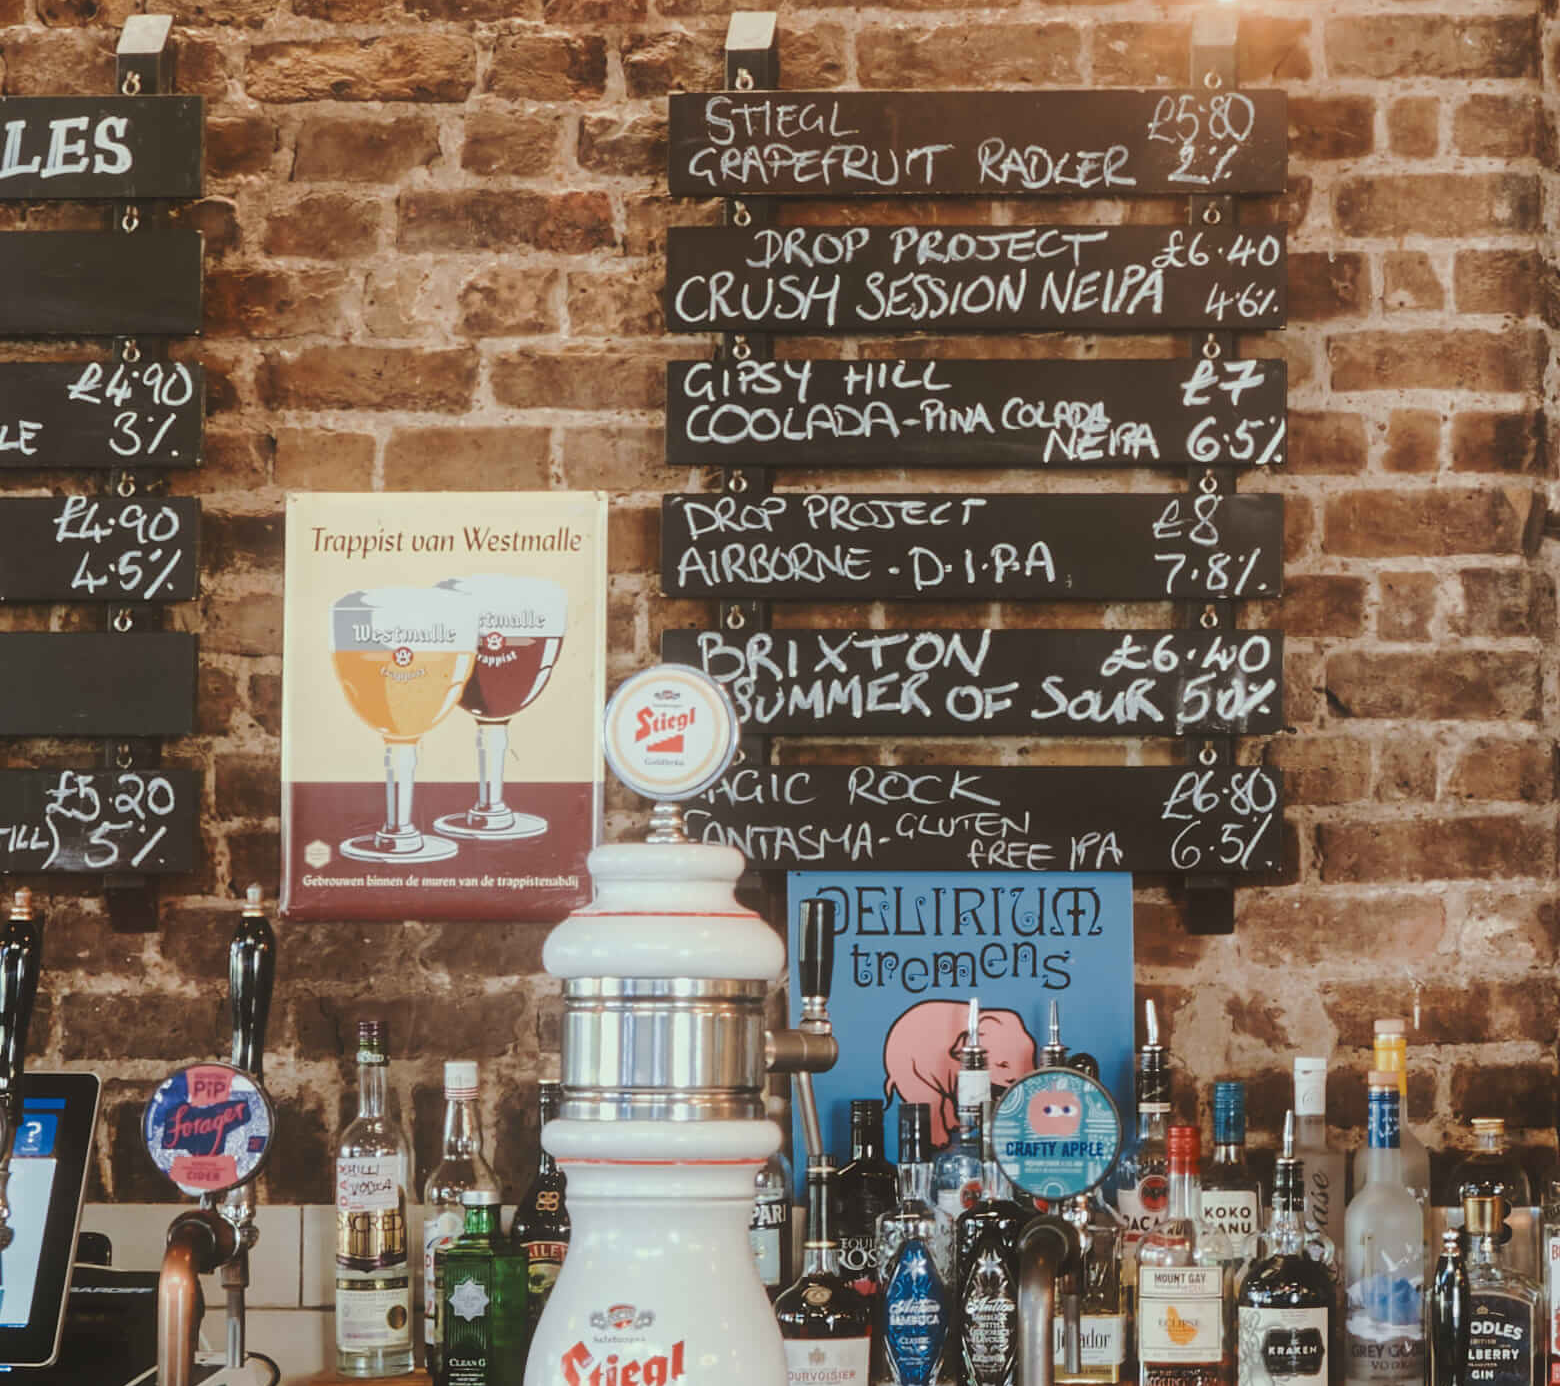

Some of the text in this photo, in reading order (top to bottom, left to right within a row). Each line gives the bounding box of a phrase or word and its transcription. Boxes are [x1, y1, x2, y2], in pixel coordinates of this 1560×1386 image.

[705, 95, 860, 146] STIEGL
[688, 136, 1138, 189] GRAPEFRUIT RADLER
[745, 227, 870, 271] DROP
[890, 225, 1110, 266] PROJECT
[674, 264, 1167, 327] CRUSH SESSION NEIPA
[682, 358, 1267, 407] GIPSY HILL £7
[682, 493, 1220, 547] DROP PROJECT £8
[310, 525, 583, 559] Trappist van Westmalle
[677, 542, 873, 589] AIRBORNE
[351, 621, 457, 644] Westmalle
[697, 628, 993, 683] BRIXTON
[945, 680, 1020, 722] OF
[634, 705, 696, 744] Stiegl
[848, 764, 1002, 808] ROCK
[895, 810, 1032, 841] GLUTEN
[1068, 831, 1125, 871] IPA
[302, 874, 365, 888] Gebrouwen
[366, 874, 403, 888] binnen
[405, 874, 420, 888] de
[421, 877, 456, 888] muren
[458, 877, 479, 888] van
[480, 874, 495, 888] de
[1005, 1141, 1105, 1158] CRAFTY APPLE
[1203, 1205, 1252, 1220] KOKO
[1153, 1272, 1182, 1285] MOUNT
[1267, 1344, 1319, 1358] KRAKEN
